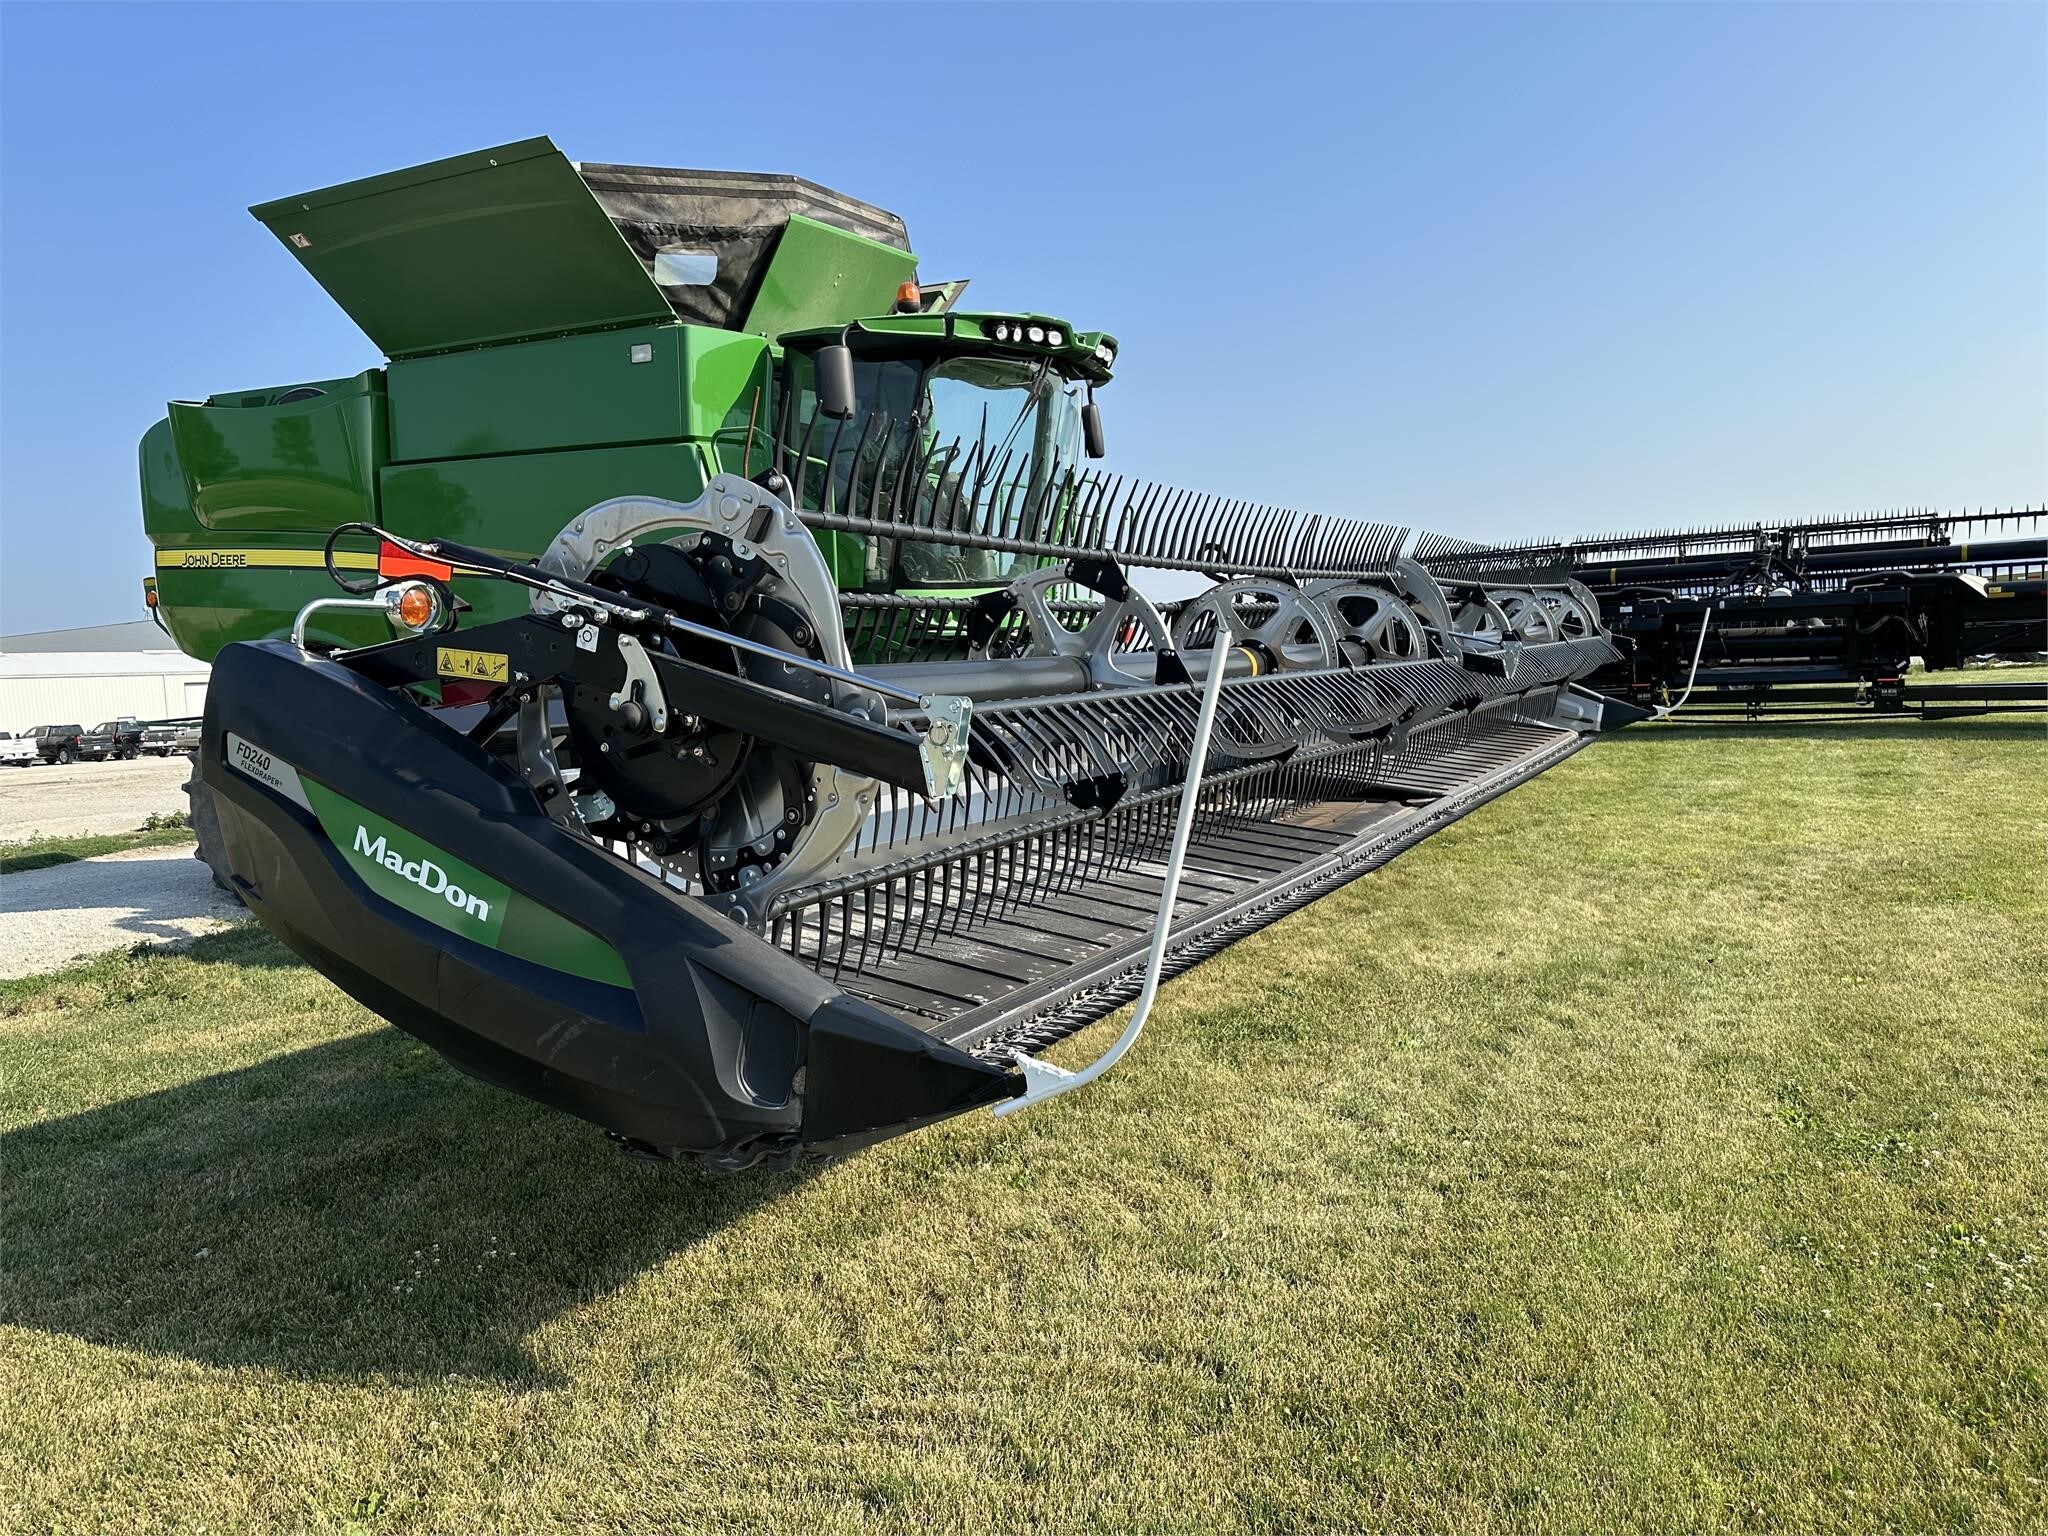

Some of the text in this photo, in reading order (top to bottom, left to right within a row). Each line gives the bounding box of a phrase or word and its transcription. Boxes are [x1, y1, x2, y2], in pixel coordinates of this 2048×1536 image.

[182, 553, 246, 566] JOHN DEERE
[236, 741, 271, 771] FD240
[353, 825, 489, 922] MacDon
